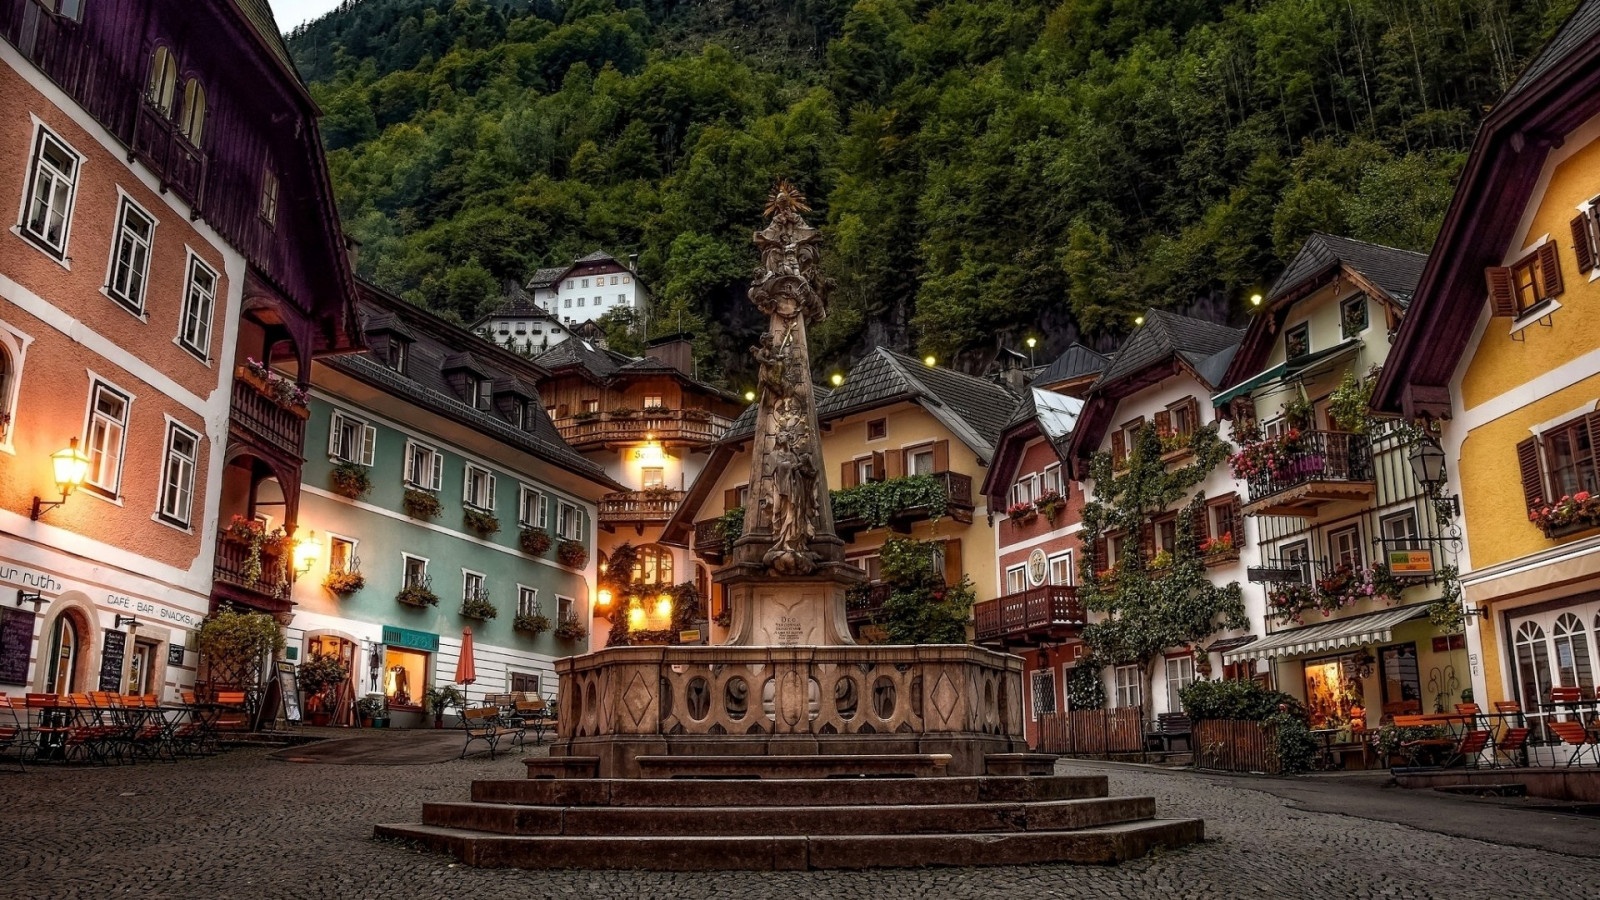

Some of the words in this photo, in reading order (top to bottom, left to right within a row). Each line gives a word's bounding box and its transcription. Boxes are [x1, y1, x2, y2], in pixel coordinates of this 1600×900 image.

[107, 594, 130, 609] CAFÉ
[136, 601, 154, 614] BAR
[160, 608, 190, 624] SNACKS
